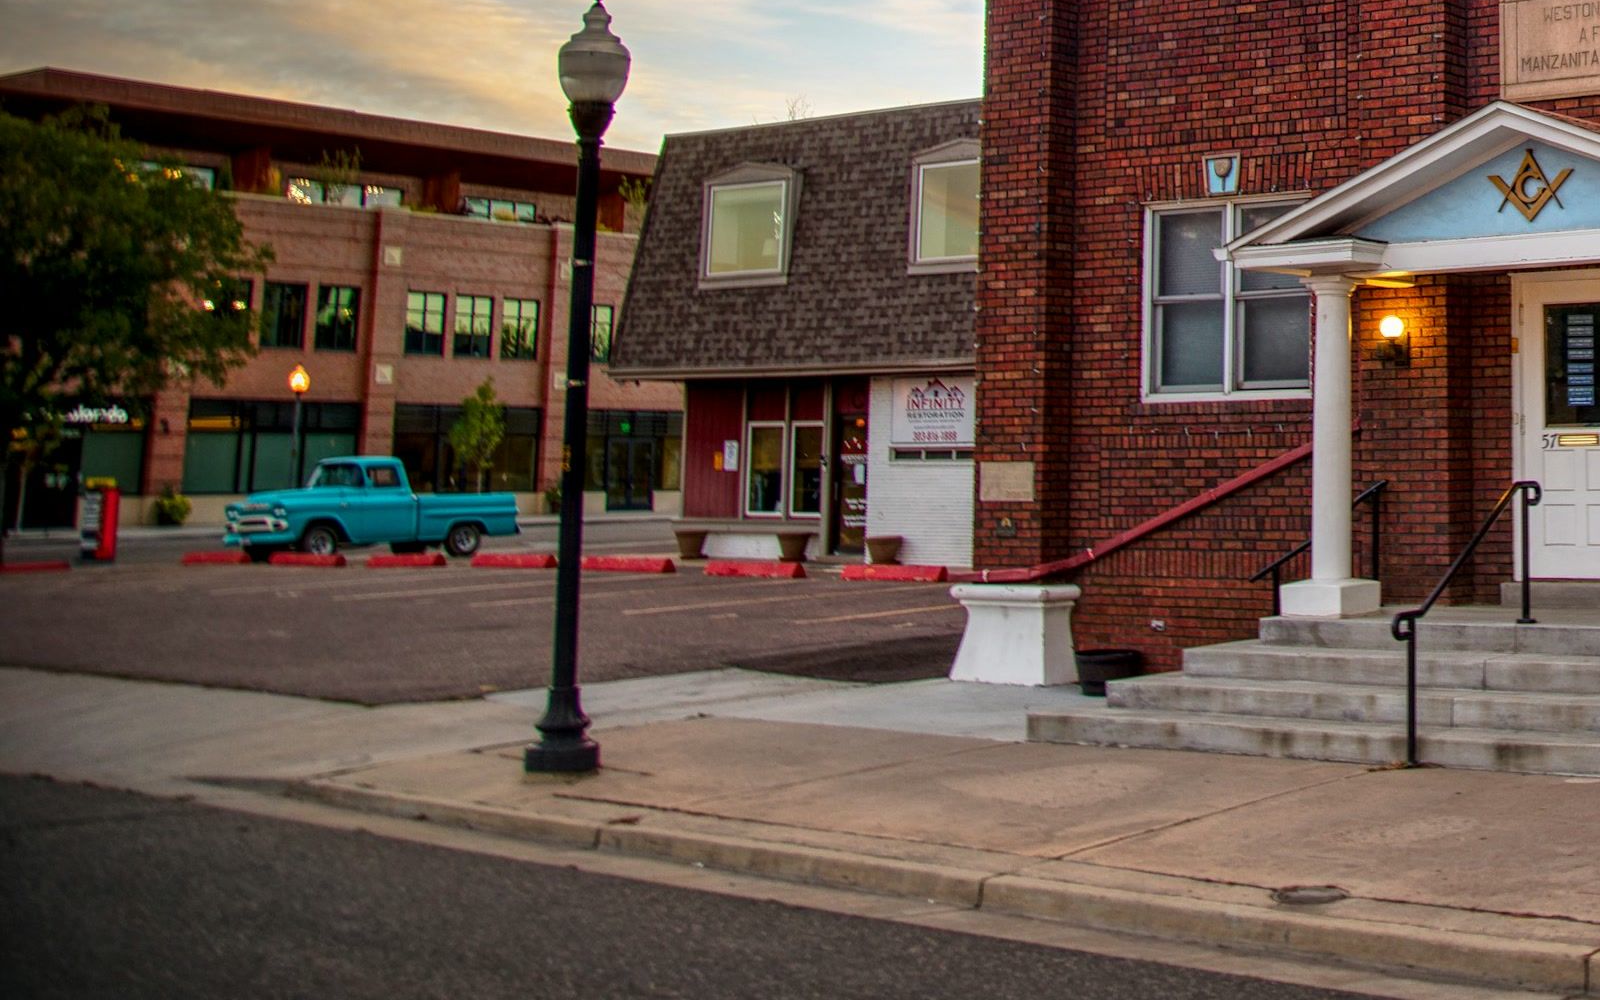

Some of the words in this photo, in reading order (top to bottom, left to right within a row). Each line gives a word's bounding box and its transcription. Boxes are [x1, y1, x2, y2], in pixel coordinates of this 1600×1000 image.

[1543, 0, 1600, 24] WESTON
[1578, 27, 1587, 43] A
[1592, 25, 1600, 40] F
[1520, 51, 1600, 73] MANZANITA
[906, 397, 964, 410] INFINITY
[906, 411, 965, 419] RESTORATION
[1542, 433, 1558, 449] 57
